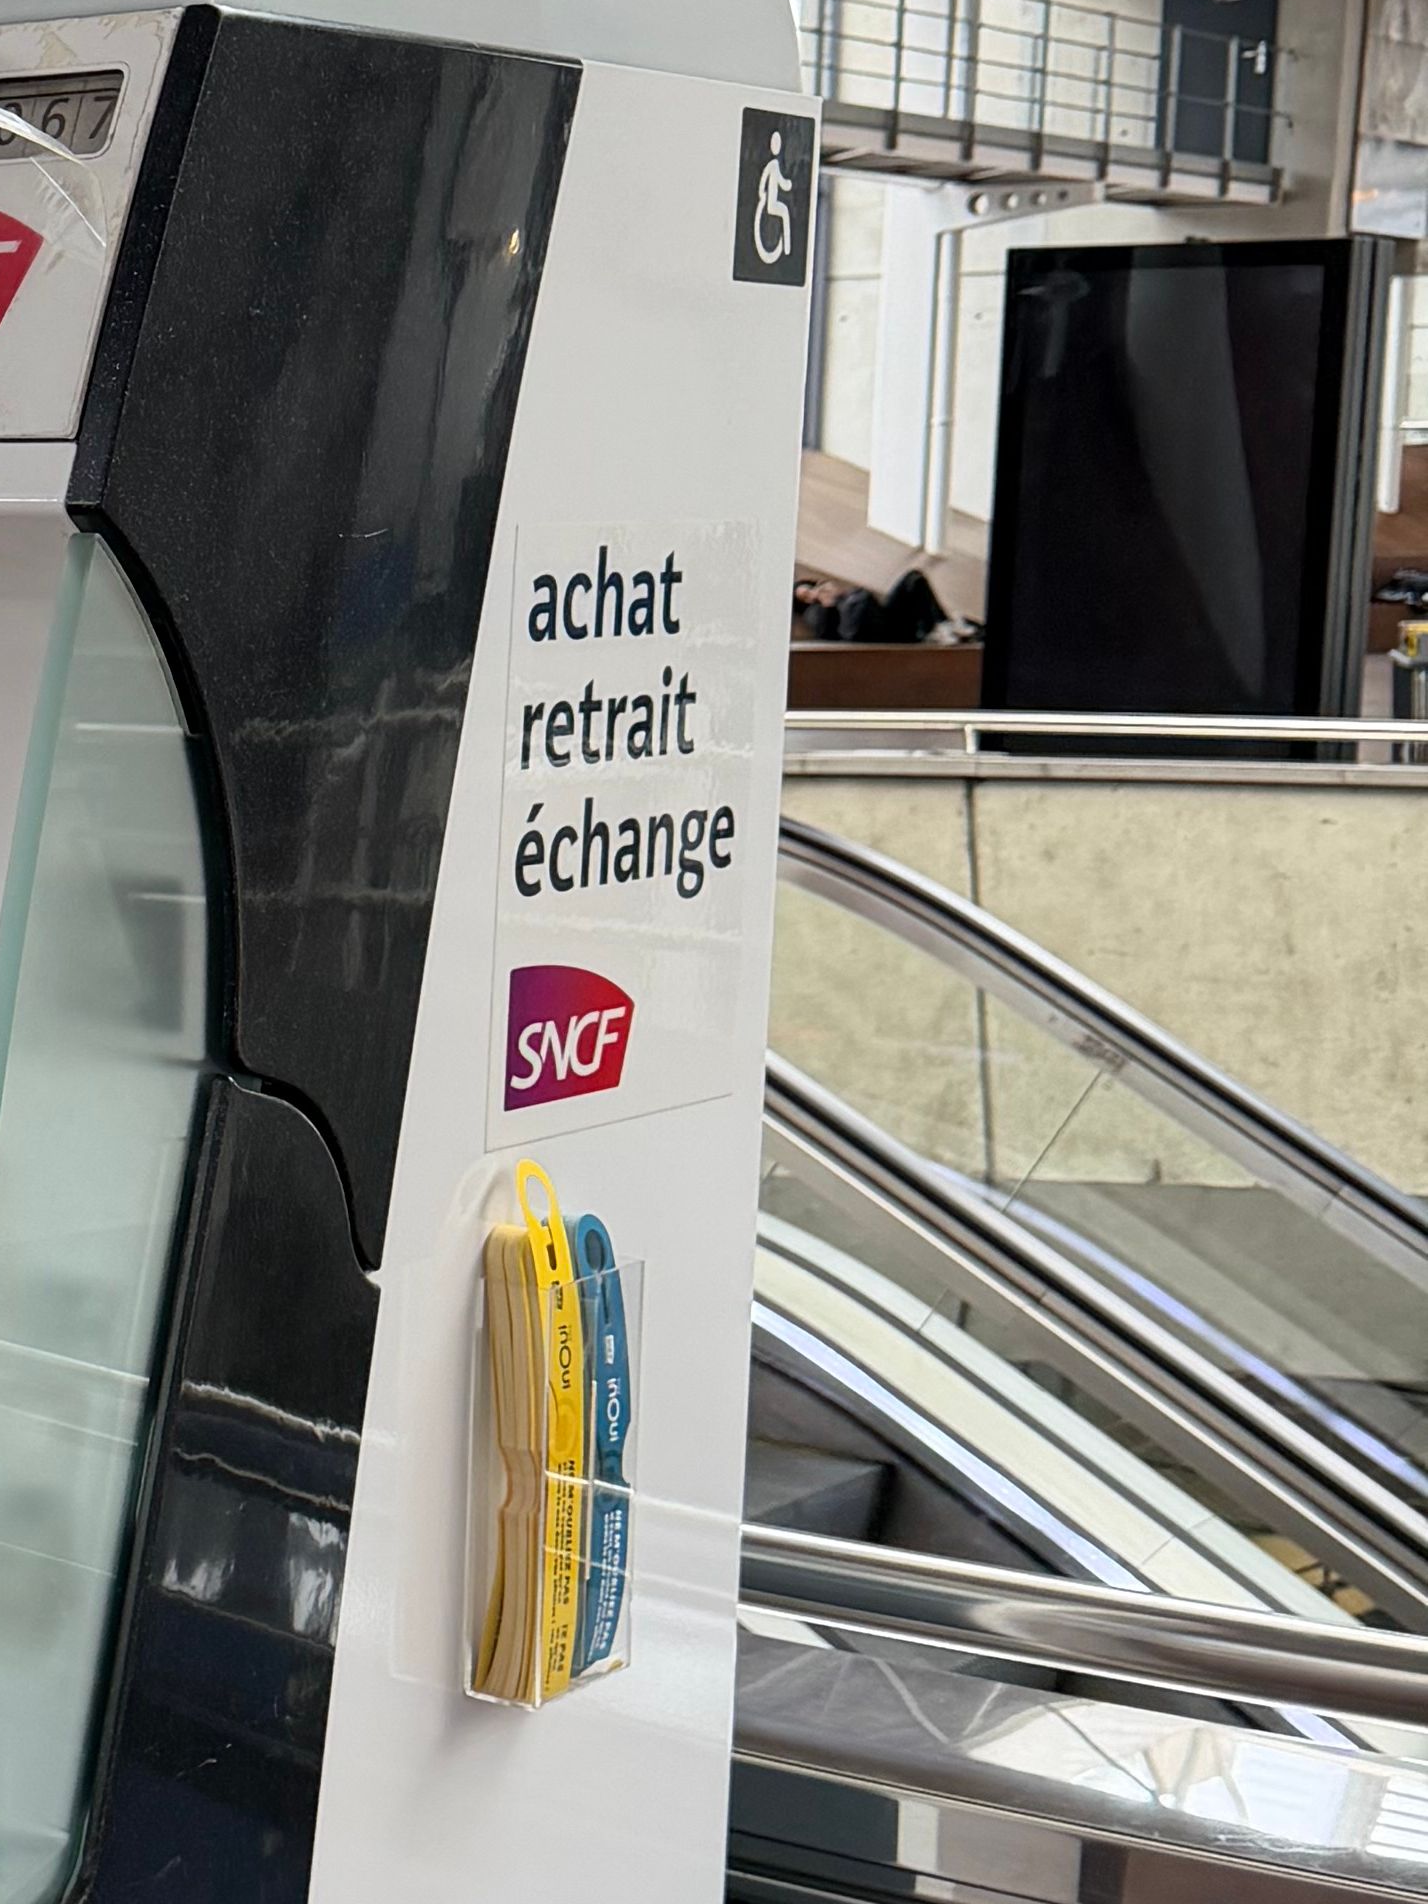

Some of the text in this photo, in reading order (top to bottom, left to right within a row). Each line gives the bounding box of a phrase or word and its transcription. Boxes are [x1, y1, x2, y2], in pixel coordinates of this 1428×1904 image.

[528, 545, 683, 642] achat
[521, 665, 696, 770] retrait
[515, 797, 735, 899] échange
[510, 1006, 626, 1090] SNCF
